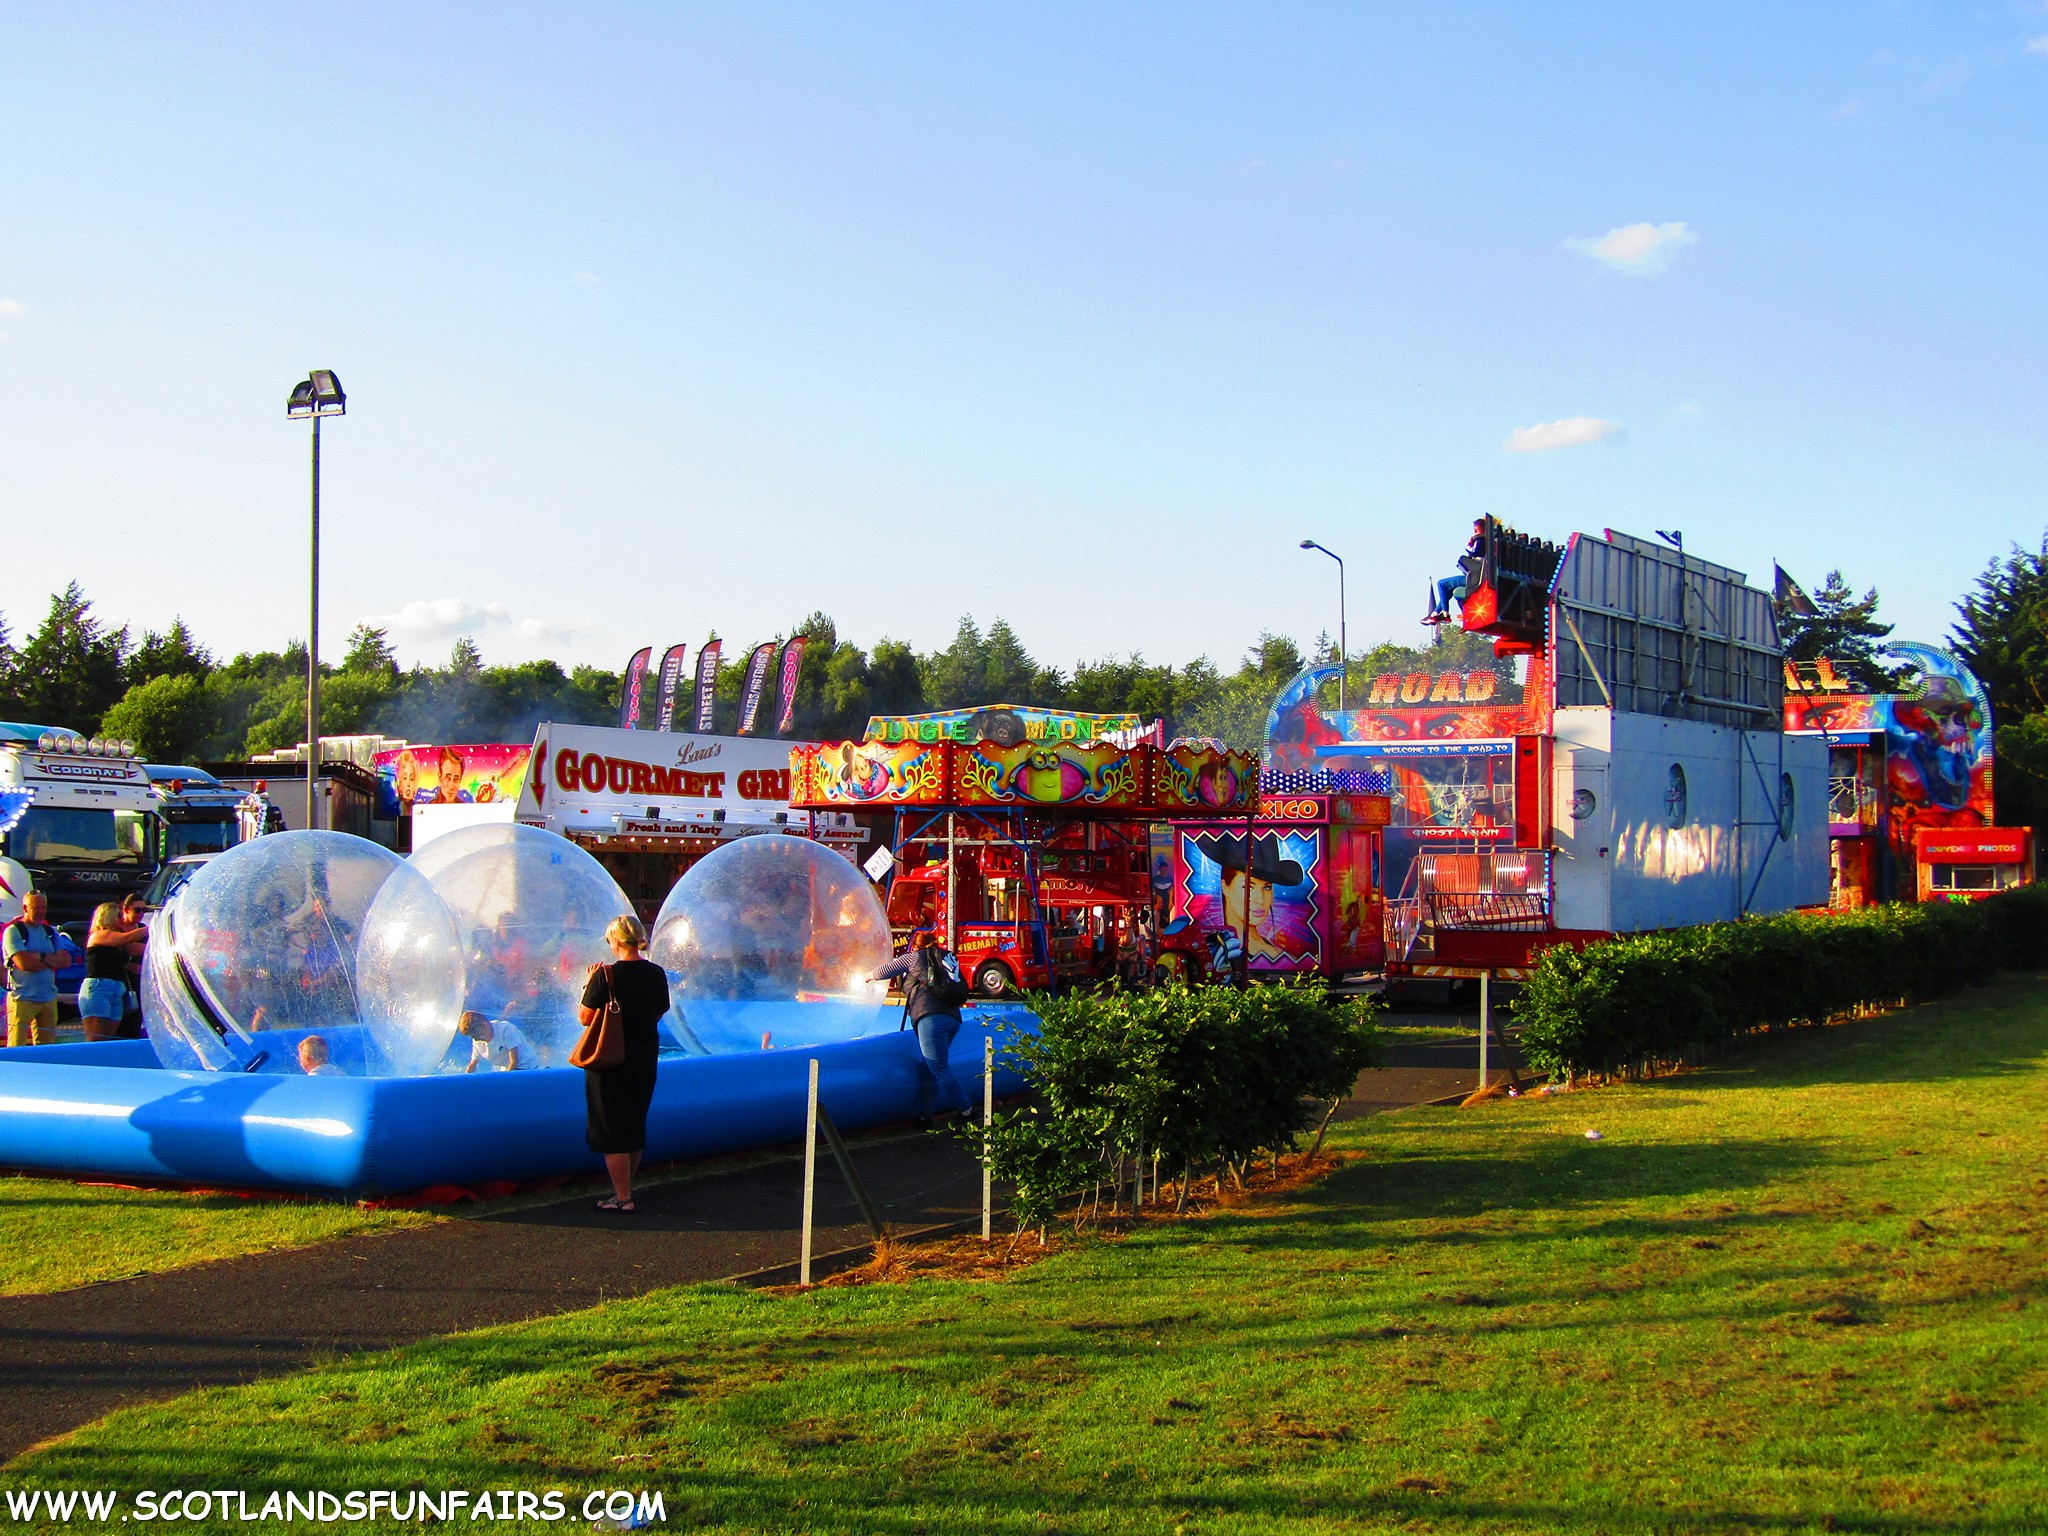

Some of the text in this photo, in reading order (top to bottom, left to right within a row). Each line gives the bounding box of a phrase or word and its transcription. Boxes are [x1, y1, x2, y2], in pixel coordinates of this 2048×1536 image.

[1784, 656, 1849, 690] LL
[628, 657, 643, 721] SLUSH
[699, 651, 716, 730] STREET FOOD
[783, 651, 797, 719] DONUTS
[1369, 670, 1497, 703] ROAD
[659, 707, 673, 732] SALT
[875, 721, 967, 741] JUNGLE
[1025, 719, 1134, 741] MADNESS
[674, 741, 722, 767] Lara's
[1383, 746, 1424, 754] WELCOME
[1428, 746, 1440, 754] TO
[1468, 745, 1493, 753] ROAD
[51, 765, 125, 778] CODONA'S
[555, 748, 790, 801] GOURMET GRI
[1254, 799, 1319, 819] XICO
[626, 822, 722, 836] Fresh and Tasty
[783, 828, 864, 838] Quality Assured
[1412, 828, 1455, 838] GHOST
[1977, 844, 2016, 853] PHOTOS
[73, 871, 120, 882] SCANIA
[958, 937, 1016, 953] FIREMAN Sam
